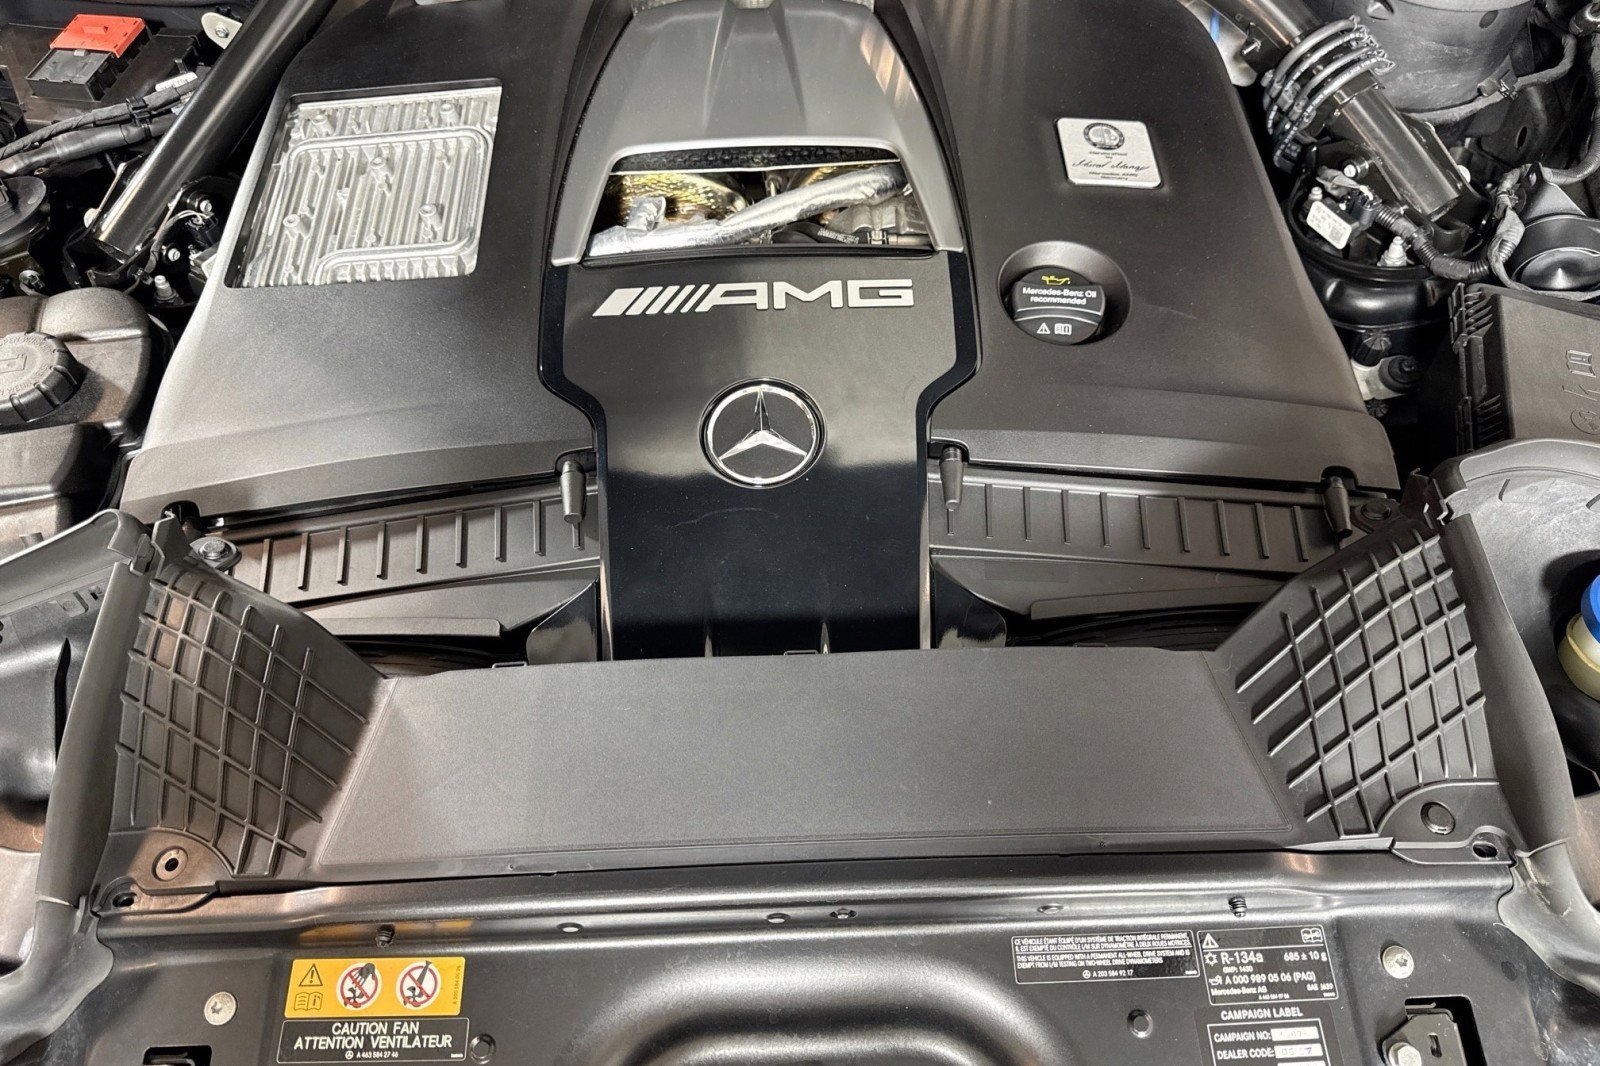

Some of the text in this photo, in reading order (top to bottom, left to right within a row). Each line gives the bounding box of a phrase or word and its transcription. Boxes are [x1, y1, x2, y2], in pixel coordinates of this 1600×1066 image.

[695, 278, 914, 312] AMG
[1023, 287, 1084, 297] Mercedes-Benz
[1030, 296, 1086, 305] recommended
[1101, 941, 1134, 949] DYNAMOMÈTRE
[1220, 950, 1264, 964] R-134a
[1284, 951, 1300, 962] 685
[1308, 950, 1320, 960] 10
[1320, 951, 1328, 962] g
[1225, 970, 1316, 985] A 000 989 05 06 (PAG)
[1210, 986, 1257, 996] Mercedes-Benz
[1258, 985, 1267, 994] AG
[1220, 1006, 1304, 1021] CAMPAIGN LABEL
[331, 1021, 420, 1036] CAUTION FAN
[293, 1034, 453, 1050] ATTENTION VENTILATEUR
[1214, 1031, 1256, 1043] CAMPAIGN
[1256, 1030, 1271, 1040] NO:
[1216, 1046, 1275, 1060] DEALER CODE:
